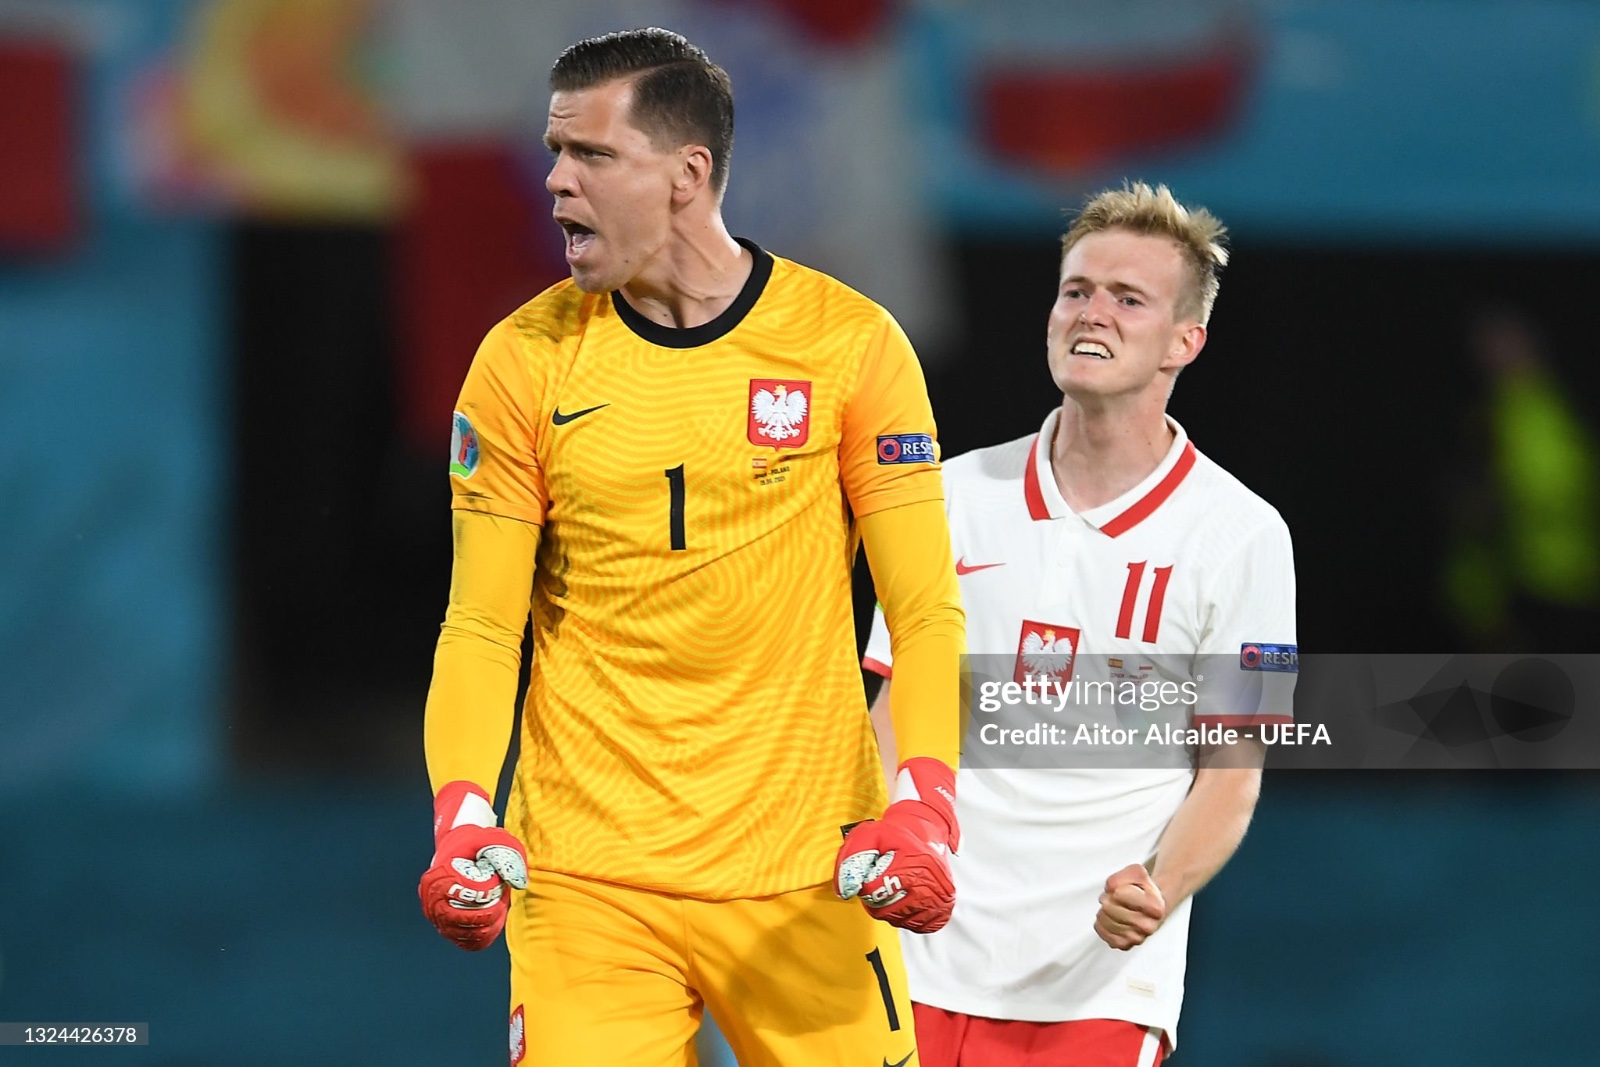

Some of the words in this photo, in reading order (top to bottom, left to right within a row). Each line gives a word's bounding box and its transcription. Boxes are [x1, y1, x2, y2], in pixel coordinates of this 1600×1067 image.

[665, 462, 686, 550] 1
[1115, 560, 1174, 644] 11
[865, 946, 900, 1031] 1
